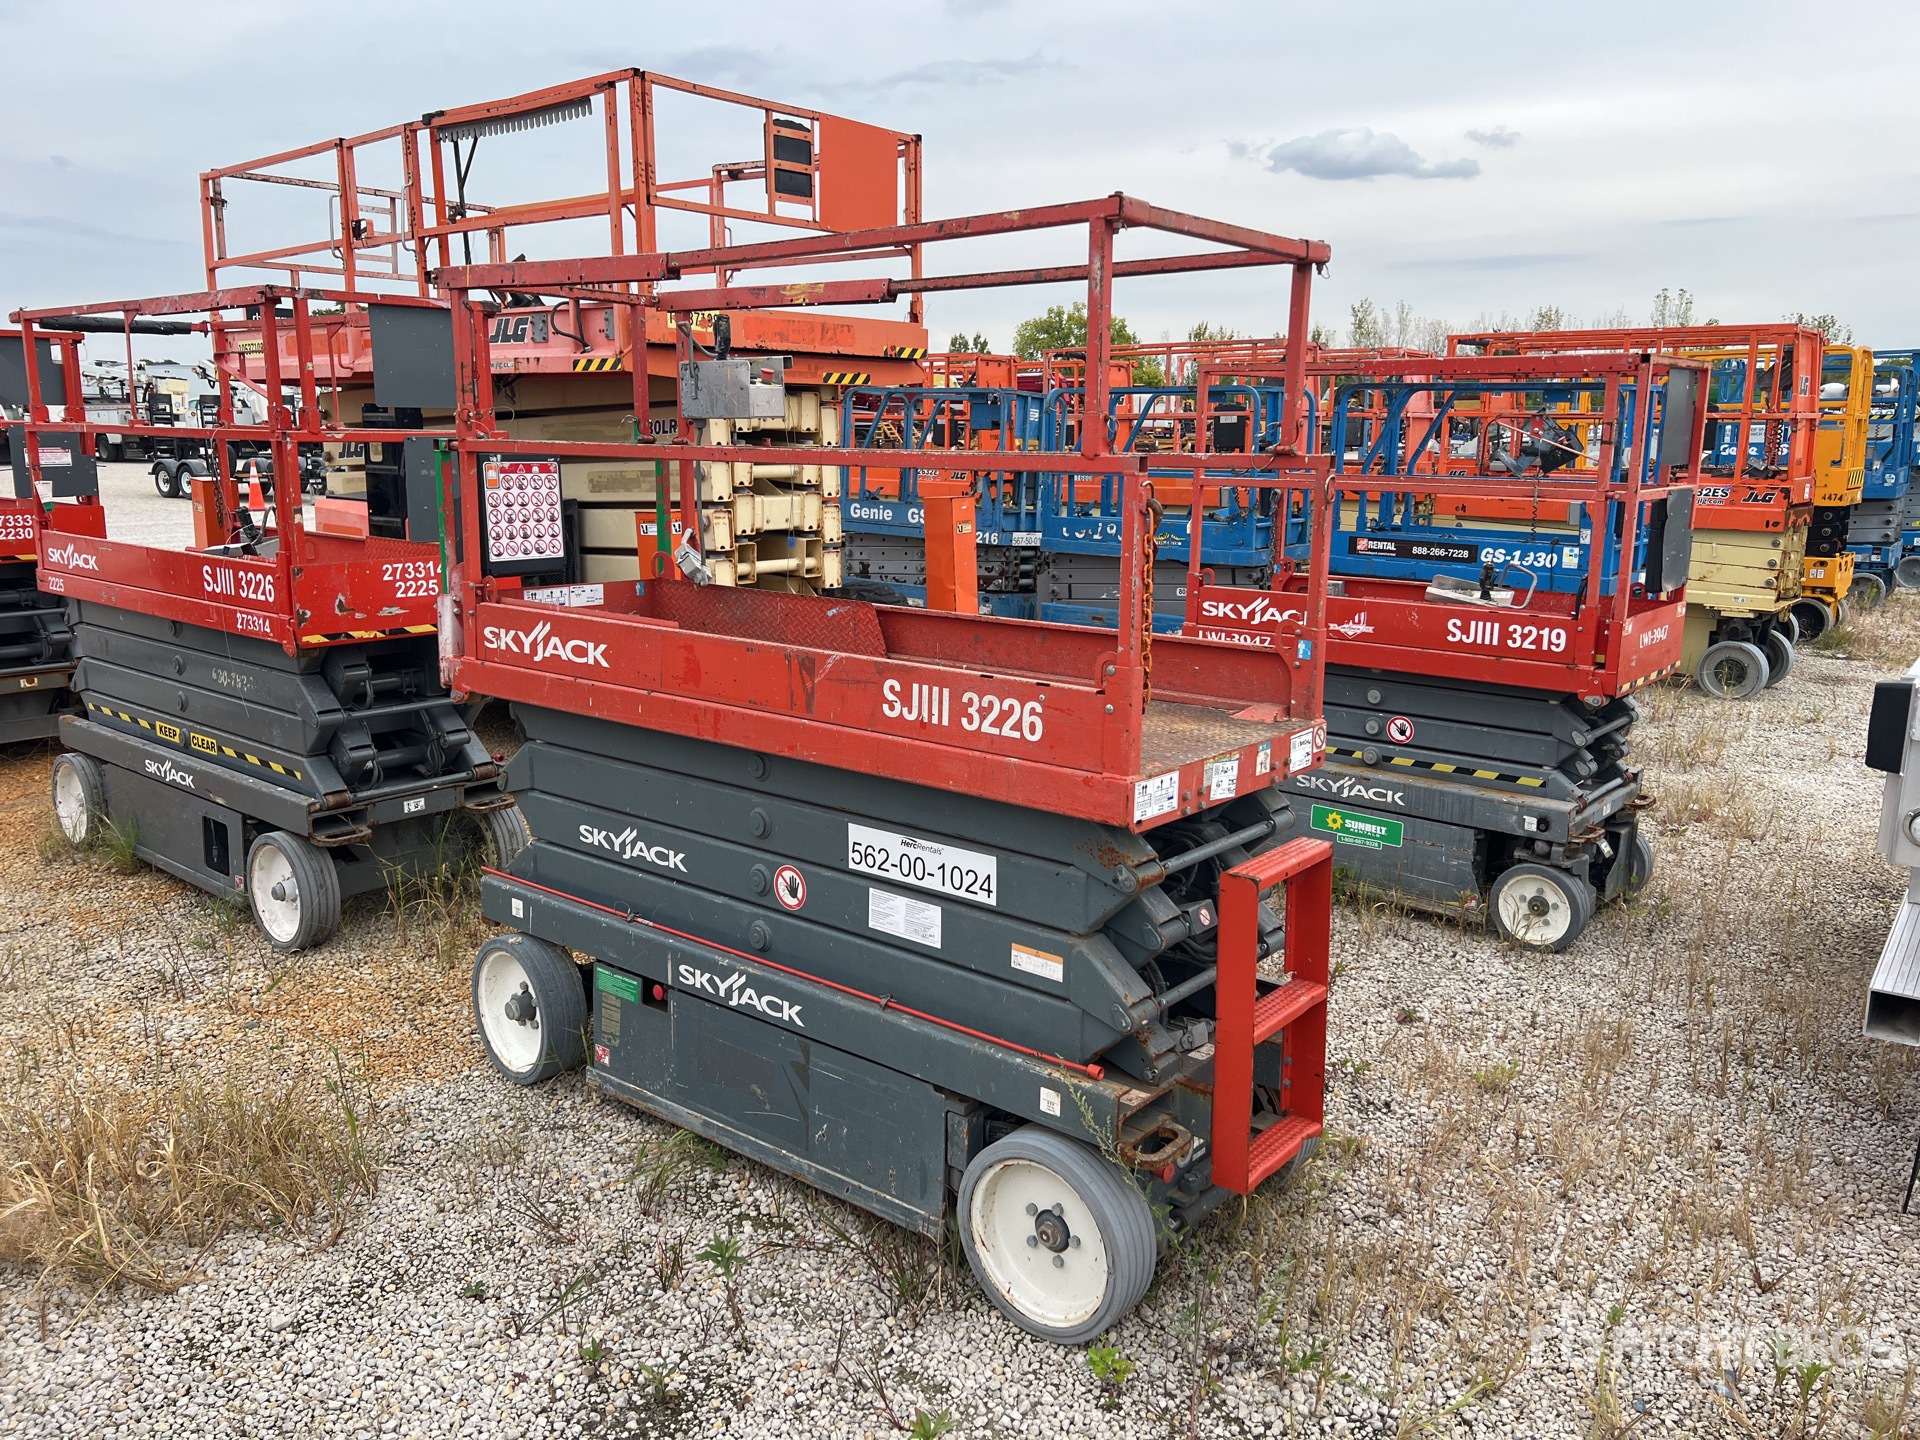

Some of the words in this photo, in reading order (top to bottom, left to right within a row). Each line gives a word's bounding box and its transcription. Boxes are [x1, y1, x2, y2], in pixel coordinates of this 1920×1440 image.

[488, 316, 530, 344] JLG
[1720, 444, 1759, 456] Gee
[951, 472, 967, 480] JLG
[850, 503, 893, 521] Genie
[48, 542, 98, 571] SKYJACK
[1368, 541, 1397, 551] RENTAL
[1411, 546, 1469, 558] 888-266-7228
[48, 576, 65, 592] 2225
[239, 570, 275, 603] 3226
[395, 579, 439, 598] 2225
[236, 612, 271, 634] 273314
[1202, 596, 1308, 626] SKYJAC
[484, 620, 611, 669] SKYJACK
[1446, 618, 1500, 647] SJIII
[1506, 624, 1568, 653] 3219
[882, 678, 951, 727] SJIII
[960, 691, 1044, 742] 3226
[158, 723, 178, 740] KEEP
[191, 735, 217, 754] CLEAR
[144, 759, 196, 789] SKYJACK
[1296, 773, 1406, 807] SKYJACK
[1344, 818, 1388, 836] SUNBELT
[579, 825, 689, 874] SKYJACK
[851, 841, 994, 899] 562-00-1024
[678, 963, 806, 1028] SKYJACK
